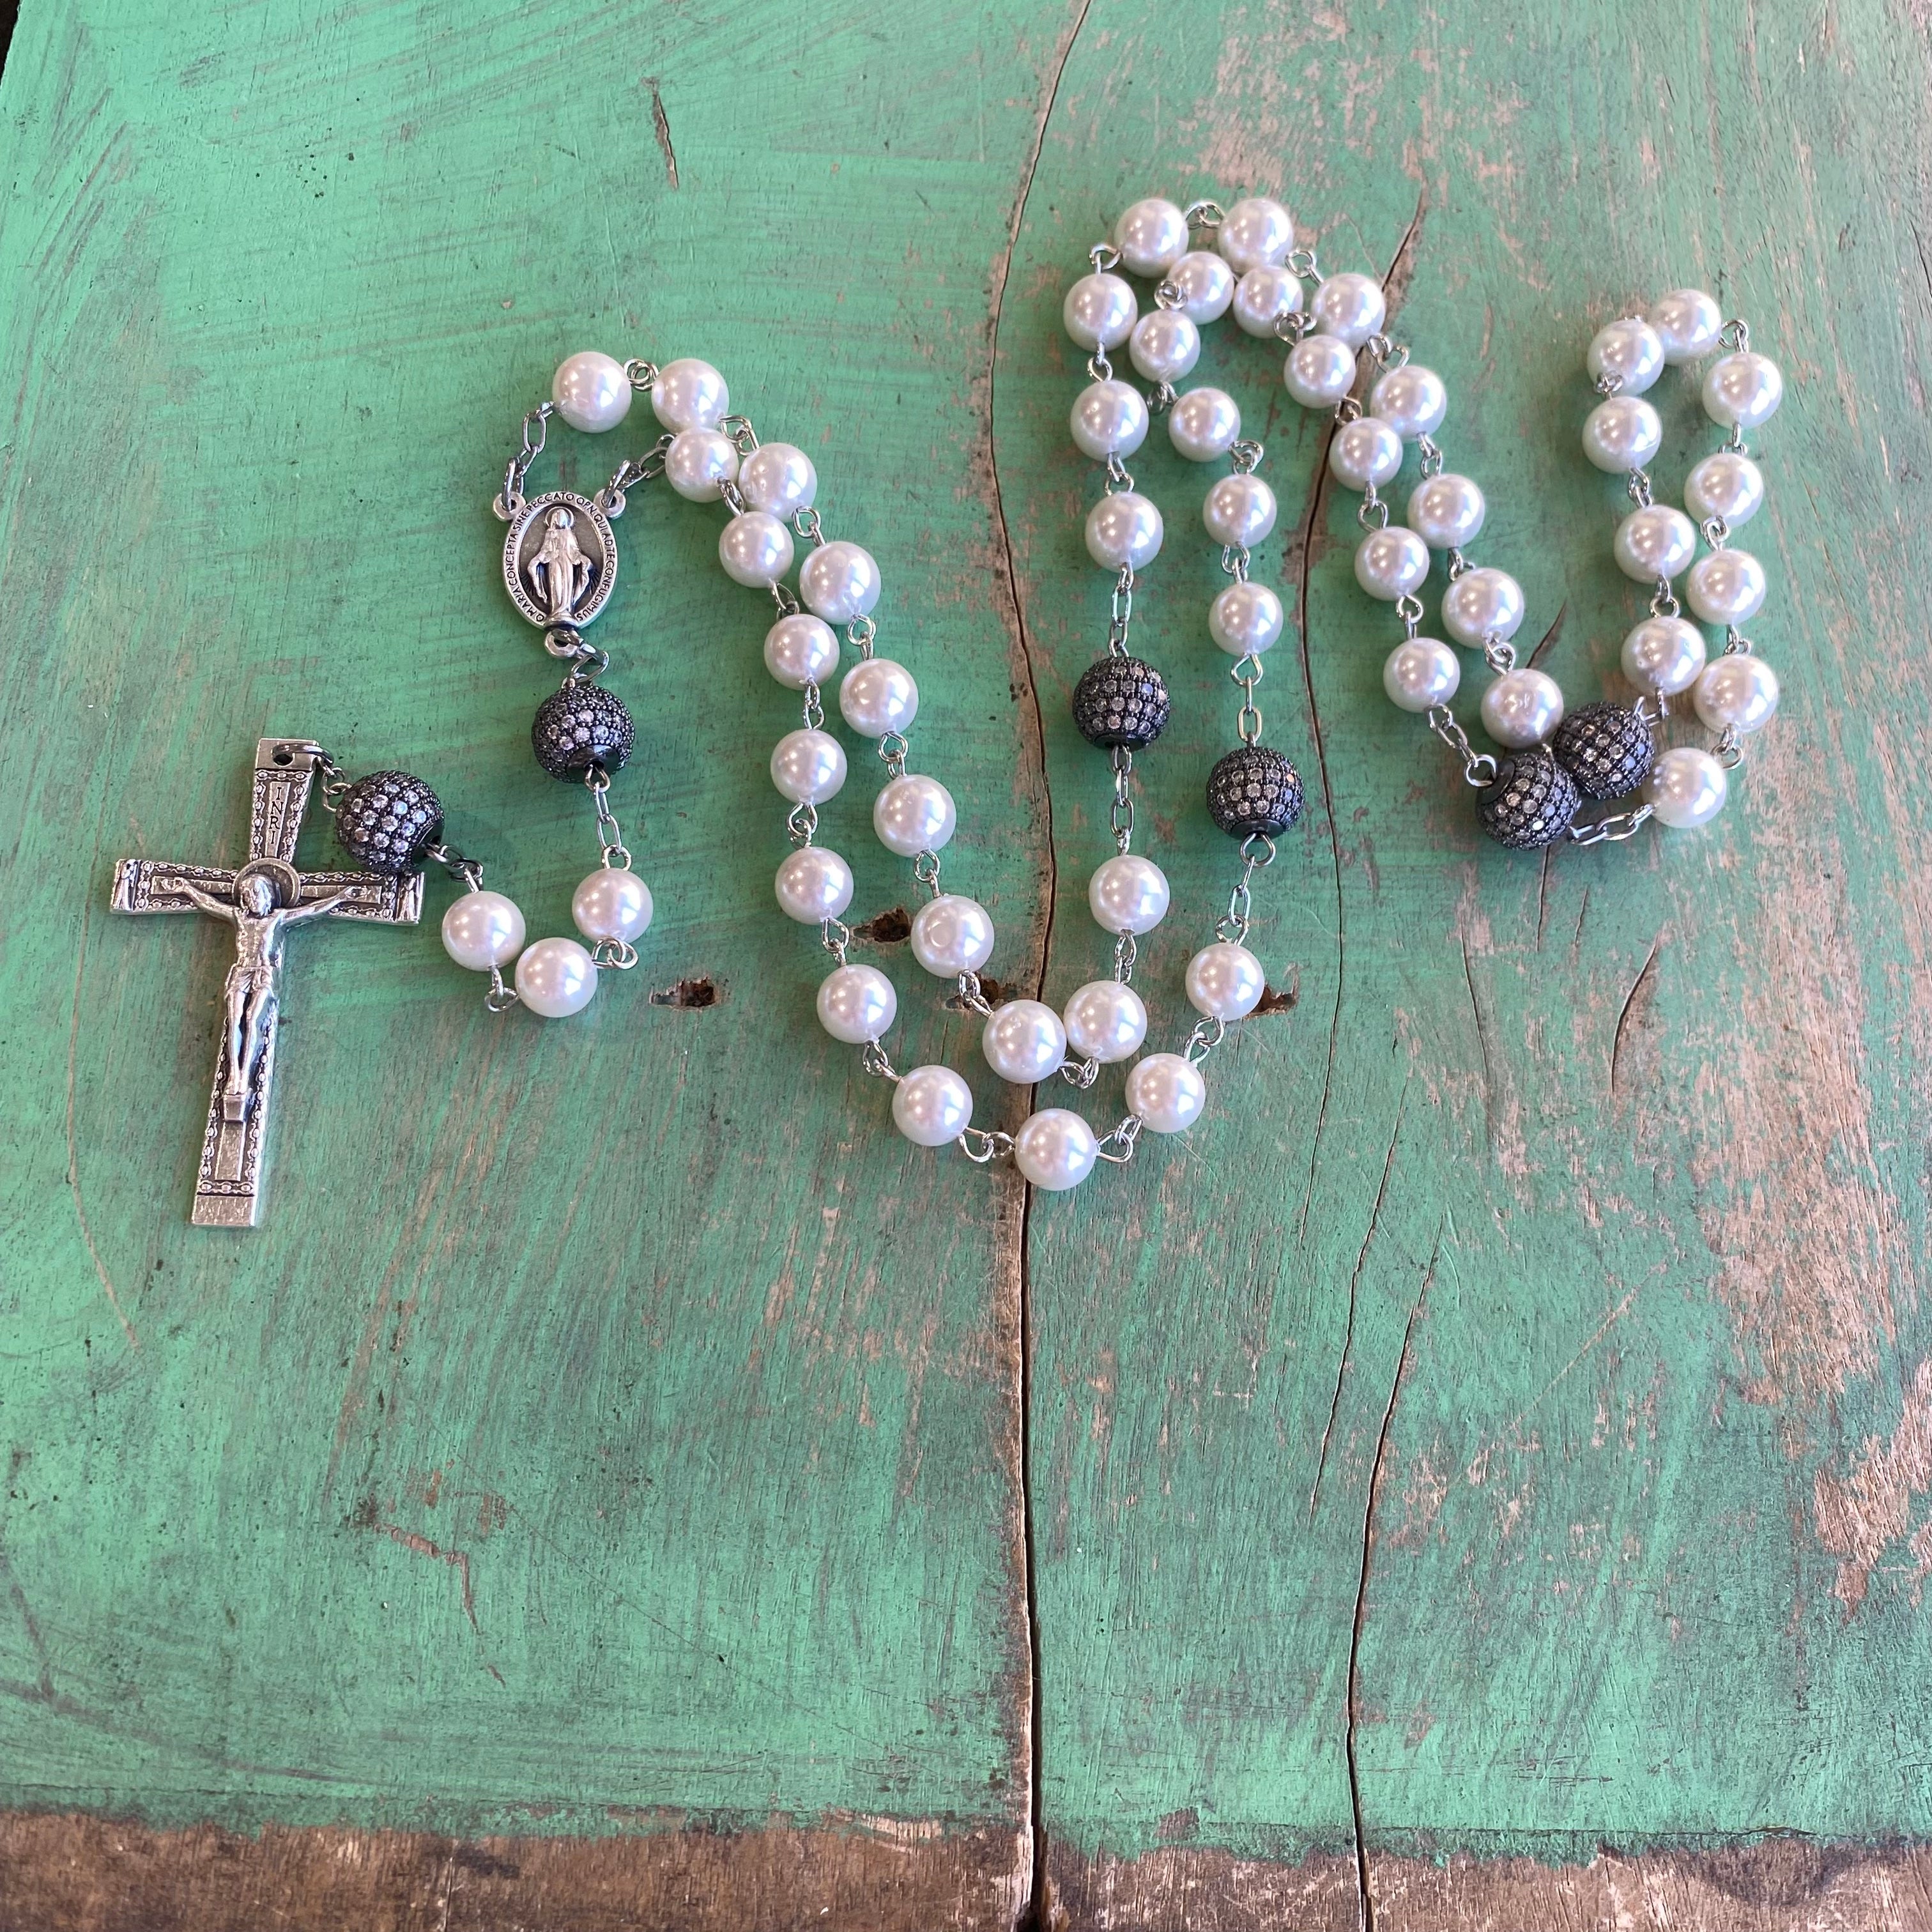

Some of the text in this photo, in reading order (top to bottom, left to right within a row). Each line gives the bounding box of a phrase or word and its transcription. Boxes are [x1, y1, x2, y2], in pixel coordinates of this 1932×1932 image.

[526, 492, 574, 511] PECCATO
[512, 510, 530, 531] SINE
[601, 533, 613, 546] AD
[505, 533, 518, 586] CONCEPTA
[606, 547, 615, 558] TE
[576, 560, 615, 621] CONFUGIMUS
[512, 586, 537, 617] MARIA
[537, 613, 544, 622] O
[268, 786, 284, 844] INRI
